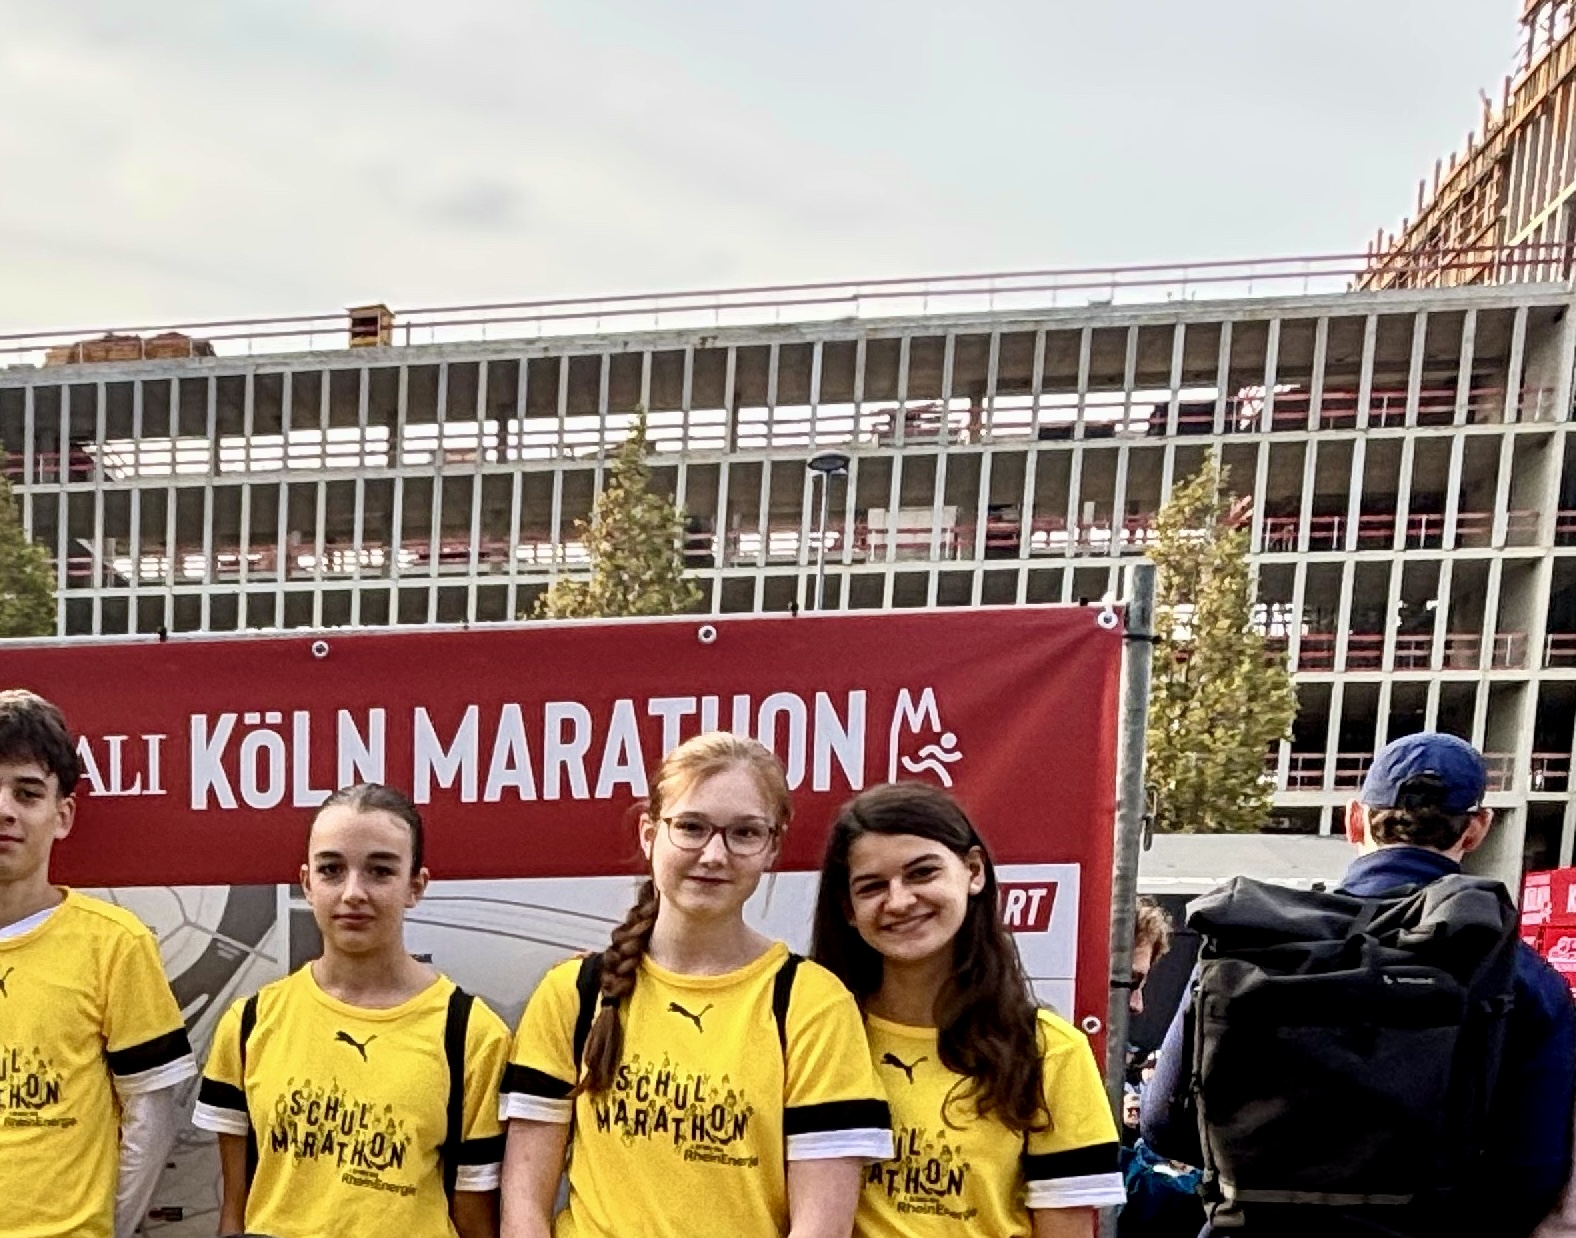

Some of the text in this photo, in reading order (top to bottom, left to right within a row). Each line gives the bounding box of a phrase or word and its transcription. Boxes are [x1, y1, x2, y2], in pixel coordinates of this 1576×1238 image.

[191, 708, 386, 811] KÖLN
[1001, 888, 1049, 927] RT
[616, 1066, 706, 1110] SCHUL
[290, 1090, 369, 1136] SCHUL
[595, 1098, 749, 1145] MARATHON
[271, 1121, 406, 1170] MARATHON
